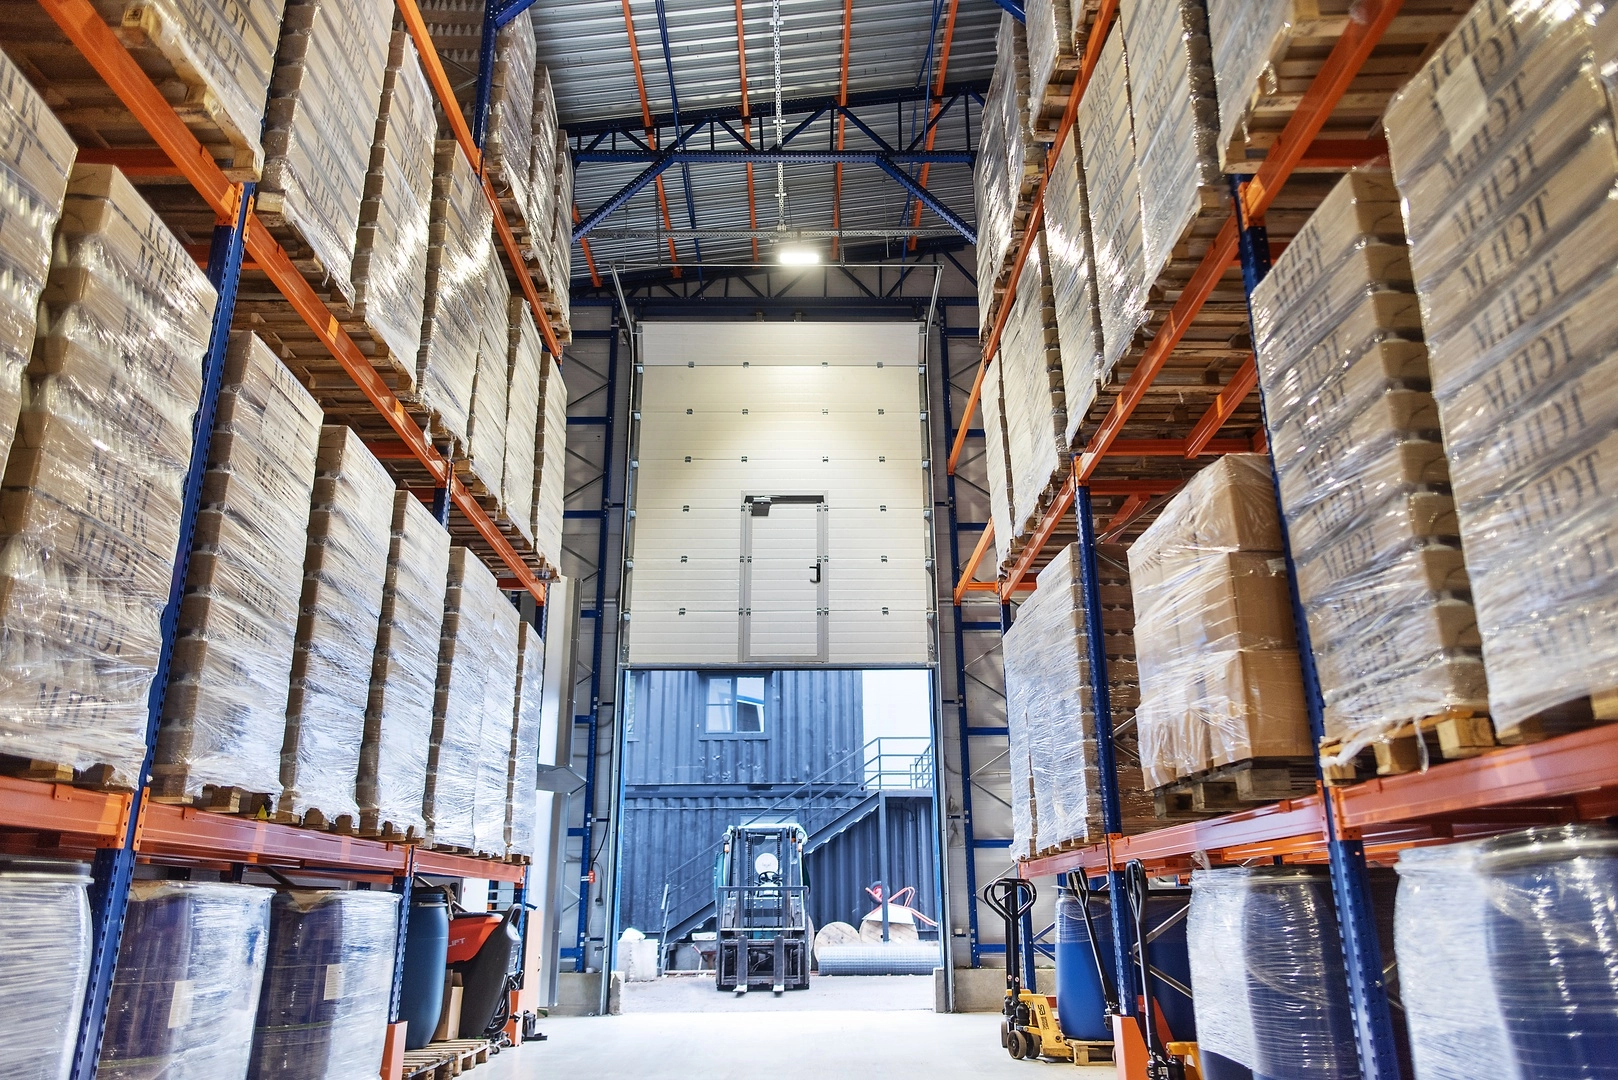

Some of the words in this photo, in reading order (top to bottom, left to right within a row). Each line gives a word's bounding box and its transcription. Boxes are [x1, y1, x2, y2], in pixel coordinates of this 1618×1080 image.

[0, 57, 43, 135] М.П
[1452, 129, 1538, 245] М.ПЭТ
[1460, 188, 1549, 300] М.ПЭТ
[1470, 252, 1560, 358] М.ПЭТ
[1483, 316, 1573, 418] М.ПЭТ
[71, 519, 144, 584] М.ПЭТ
[1320, 523, 1377, 582] М.ПЭТ
